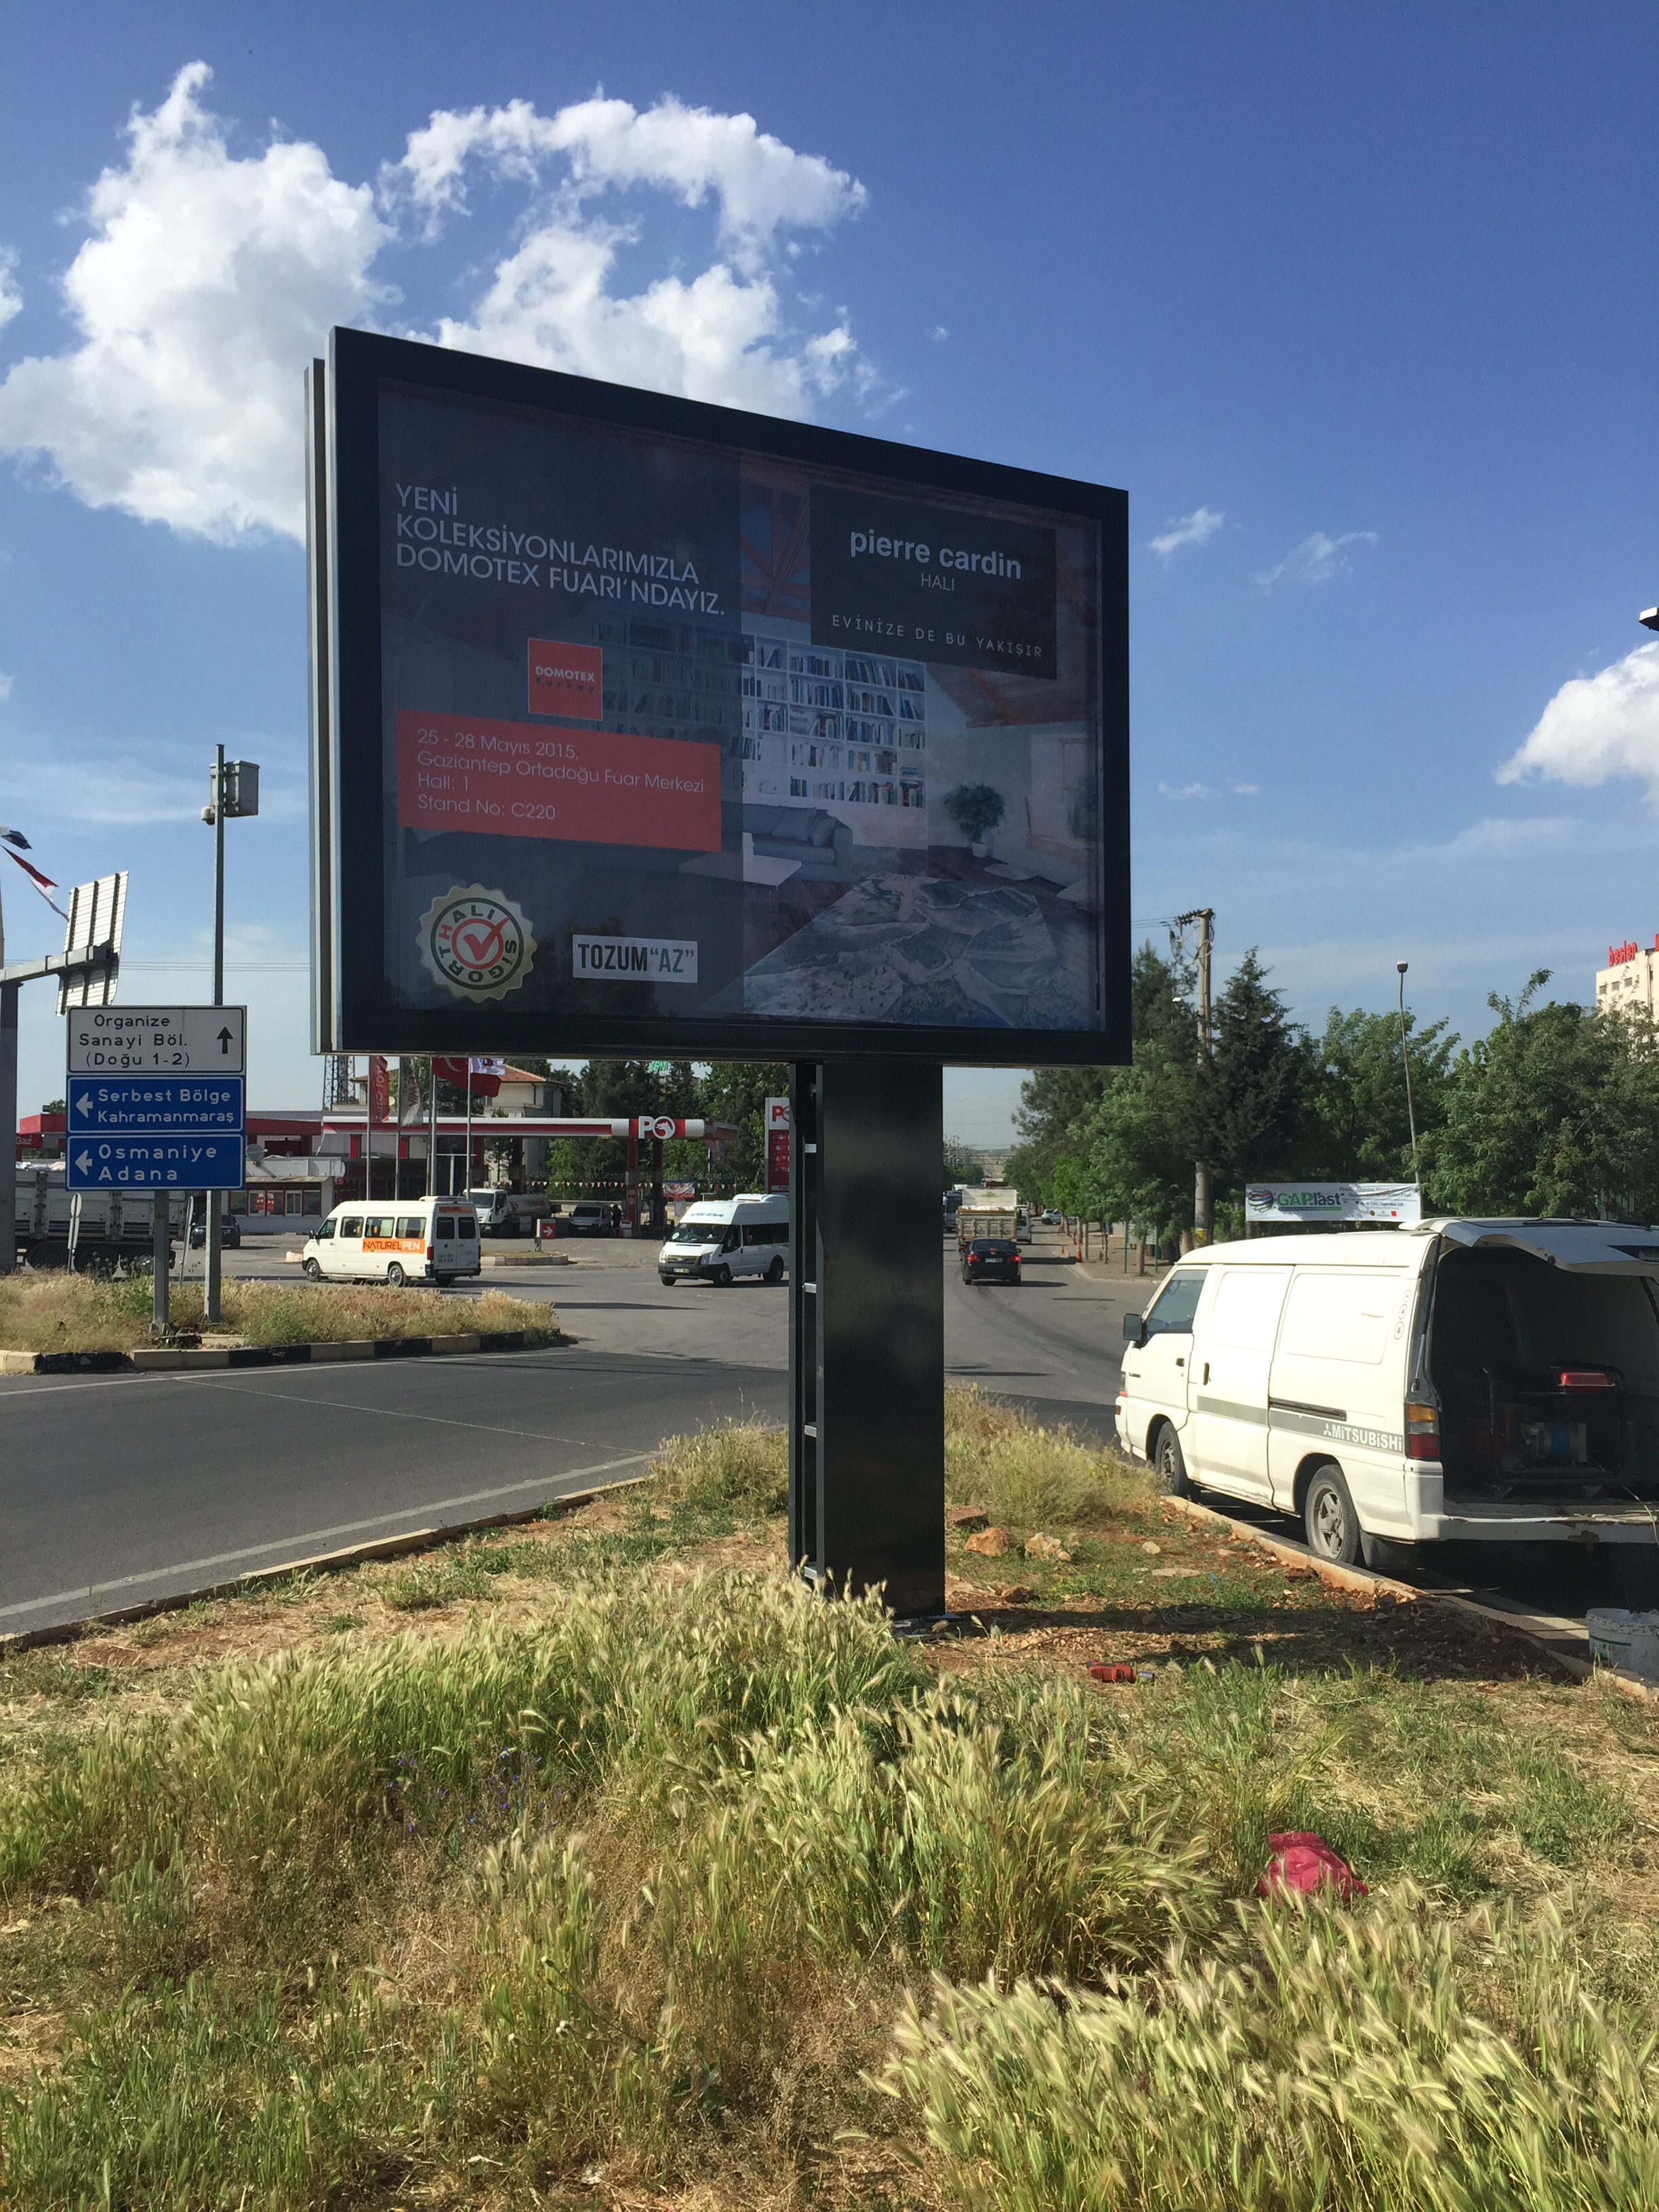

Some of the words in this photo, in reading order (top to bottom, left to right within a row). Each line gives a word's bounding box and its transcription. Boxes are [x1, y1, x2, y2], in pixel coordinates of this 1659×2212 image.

[395, 483, 458, 516] YENİ
[396, 513, 699, 584] KOLEKSİYONLARIMIZLA
[851, 529, 930, 564] pierre
[939, 548, 1021, 579] cardin
[396, 544, 540, 588] DOMOTEX
[920, 573, 955, 592] HALI
[832, 614, 905, 637] EVİNİZE
[916, 628, 935, 641] DE
[946, 633, 965, 646] BU
[976, 638, 1042, 658] YAKIŞIR
[535, 665, 595, 682] DOMOTEX
[417, 729, 438, 745] 25
[455, 732, 475, 748] 28
[480, 735, 530, 756] Mayıs
[417, 750, 510, 776] Gaziantep
[516, 760, 600, 785] Ortadoğu
[605, 770, 640, 787] Fuar
[644, 775, 704, 793] Merkezi
[417, 773, 455, 790] Hall:
[462, 775, 469, 791] 1
[417, 794, 470, 813] Stand
[476, 800, 505, 816] No:
[512, 802, 556, 820] C220
[94, 1014, 170, 1029] Organize
[79, 1033, 142, 1049] Sanayi
[153, 1033, 188, 1046] Böl.
[86, 1052, 142, 1069] (Doğu
[152, 1052, 190, 1068] 1-2)
[98, 1089, 172, 1102] Serbest
[180, 1089, 230, 1105] Bölge
[98, 1110, 234, 1124] Kahramanmaraş
[98, 1145, 218, 1163] Osmaniye
[98, 1166, 178, 1181] Adana
